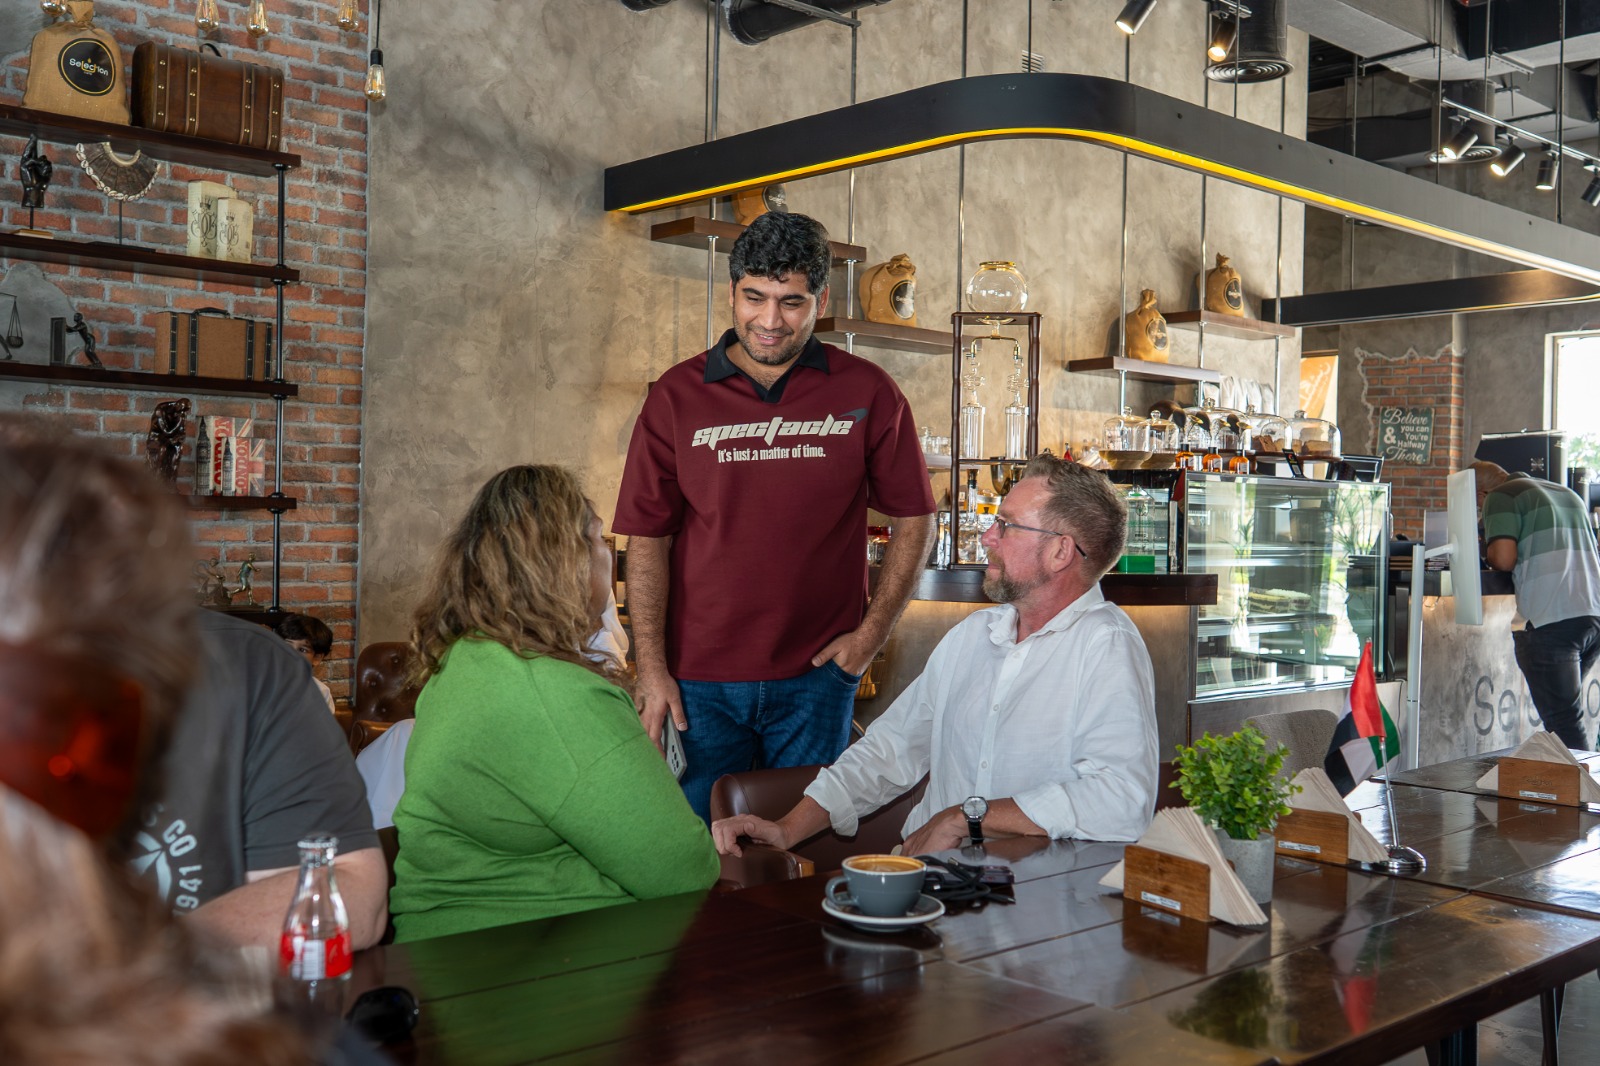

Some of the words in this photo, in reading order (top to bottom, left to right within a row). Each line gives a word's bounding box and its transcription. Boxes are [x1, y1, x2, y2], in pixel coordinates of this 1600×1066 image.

[69, 58, 109, 76] Selection
[1382, 409, 1428, 425] Believe
[692, 413, 854, 451] spectacle
[1383, 426, 1397, 444] &
[1400, 425, 1415, 433] you
[1404, 433, 1429, 441] You're
[718, 449, 733, 463] It's
[751, 449, 759, 461] a
[791, 444, 802, 458] of
[802, 444, 826, 458] time.
[1397, 440, 1426, 450] Halfway
[1385, 446, 1427, 462] There.
[162, 819, 197, 857] CO
